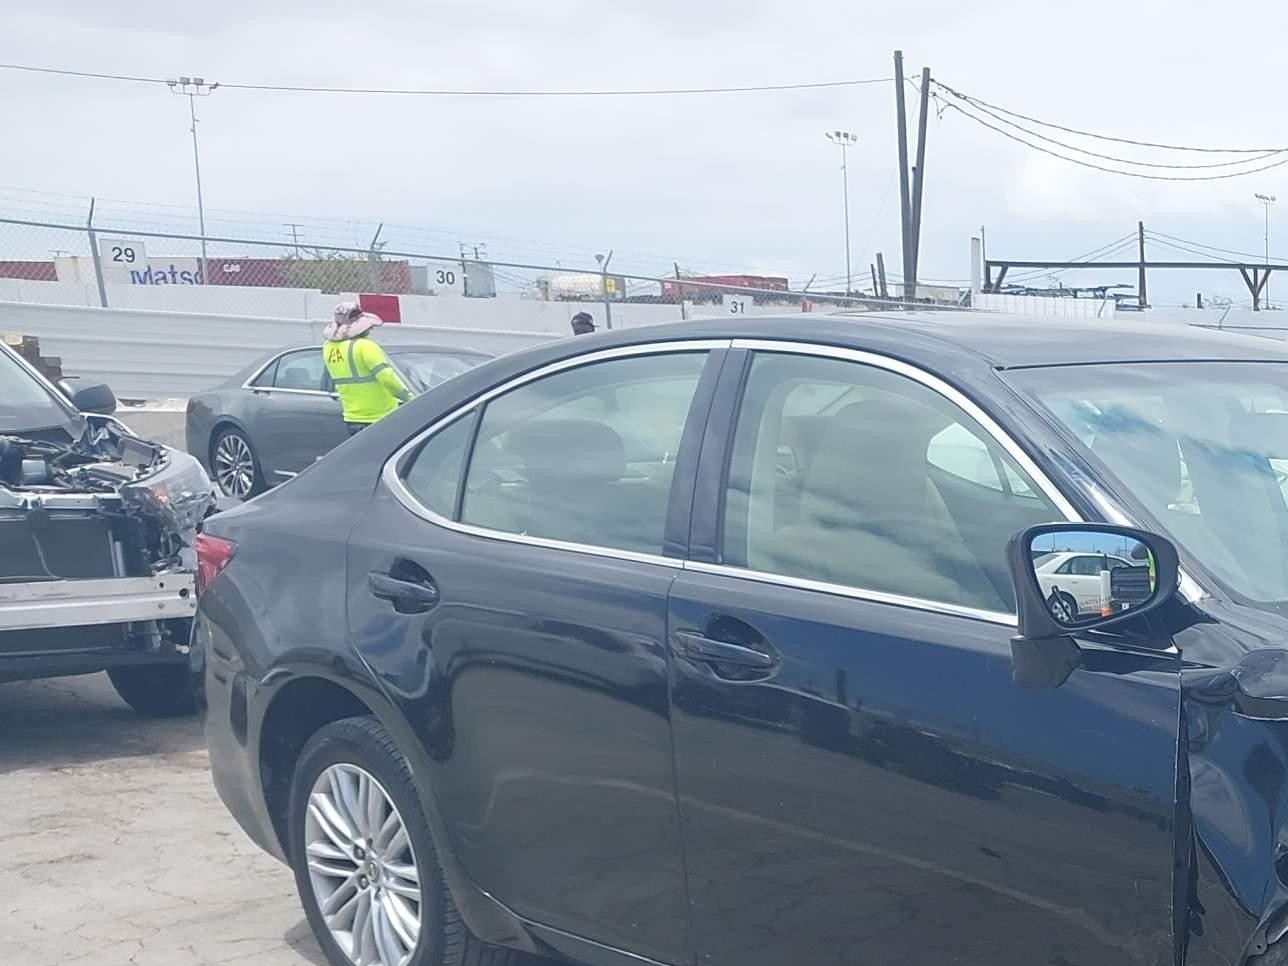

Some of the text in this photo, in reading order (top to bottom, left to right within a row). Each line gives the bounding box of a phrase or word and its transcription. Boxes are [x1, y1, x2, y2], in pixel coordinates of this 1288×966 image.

[111, 246, 136, 263] 29
[436, 270, 455, 285] 30
[730, 300, 745, 314] 31
